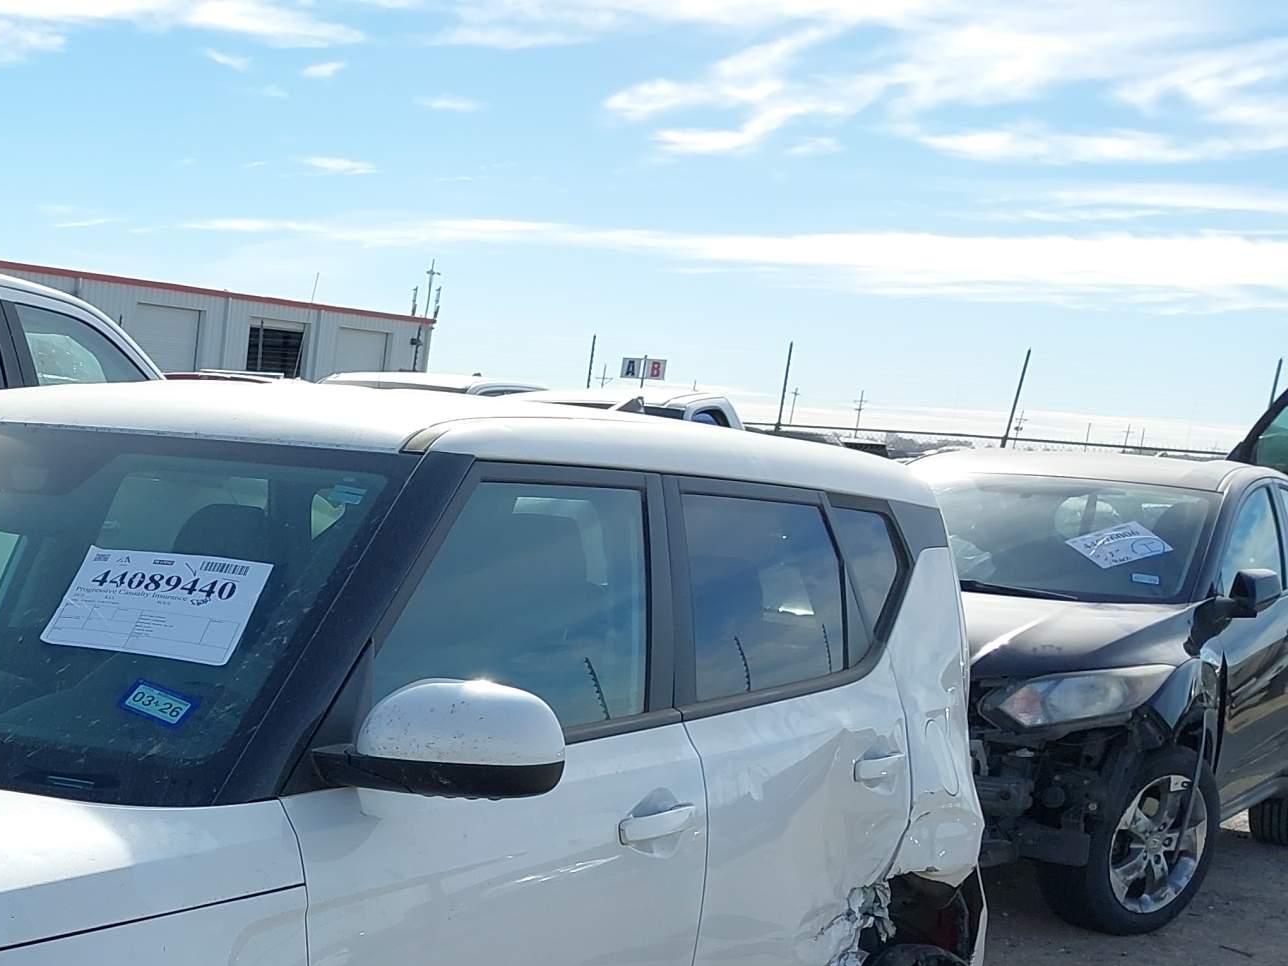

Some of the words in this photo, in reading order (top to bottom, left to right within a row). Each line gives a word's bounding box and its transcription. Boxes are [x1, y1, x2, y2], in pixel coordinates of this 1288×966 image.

[626, 360, 635, 376] A
[651, 361, 661, 377] B
[92, 569, 237, 600] 44089440
[75, 586, 119, 595] Progressive
[119, 589, 149, 598] Casualty
[152, 591, 189, 602] Insurance
